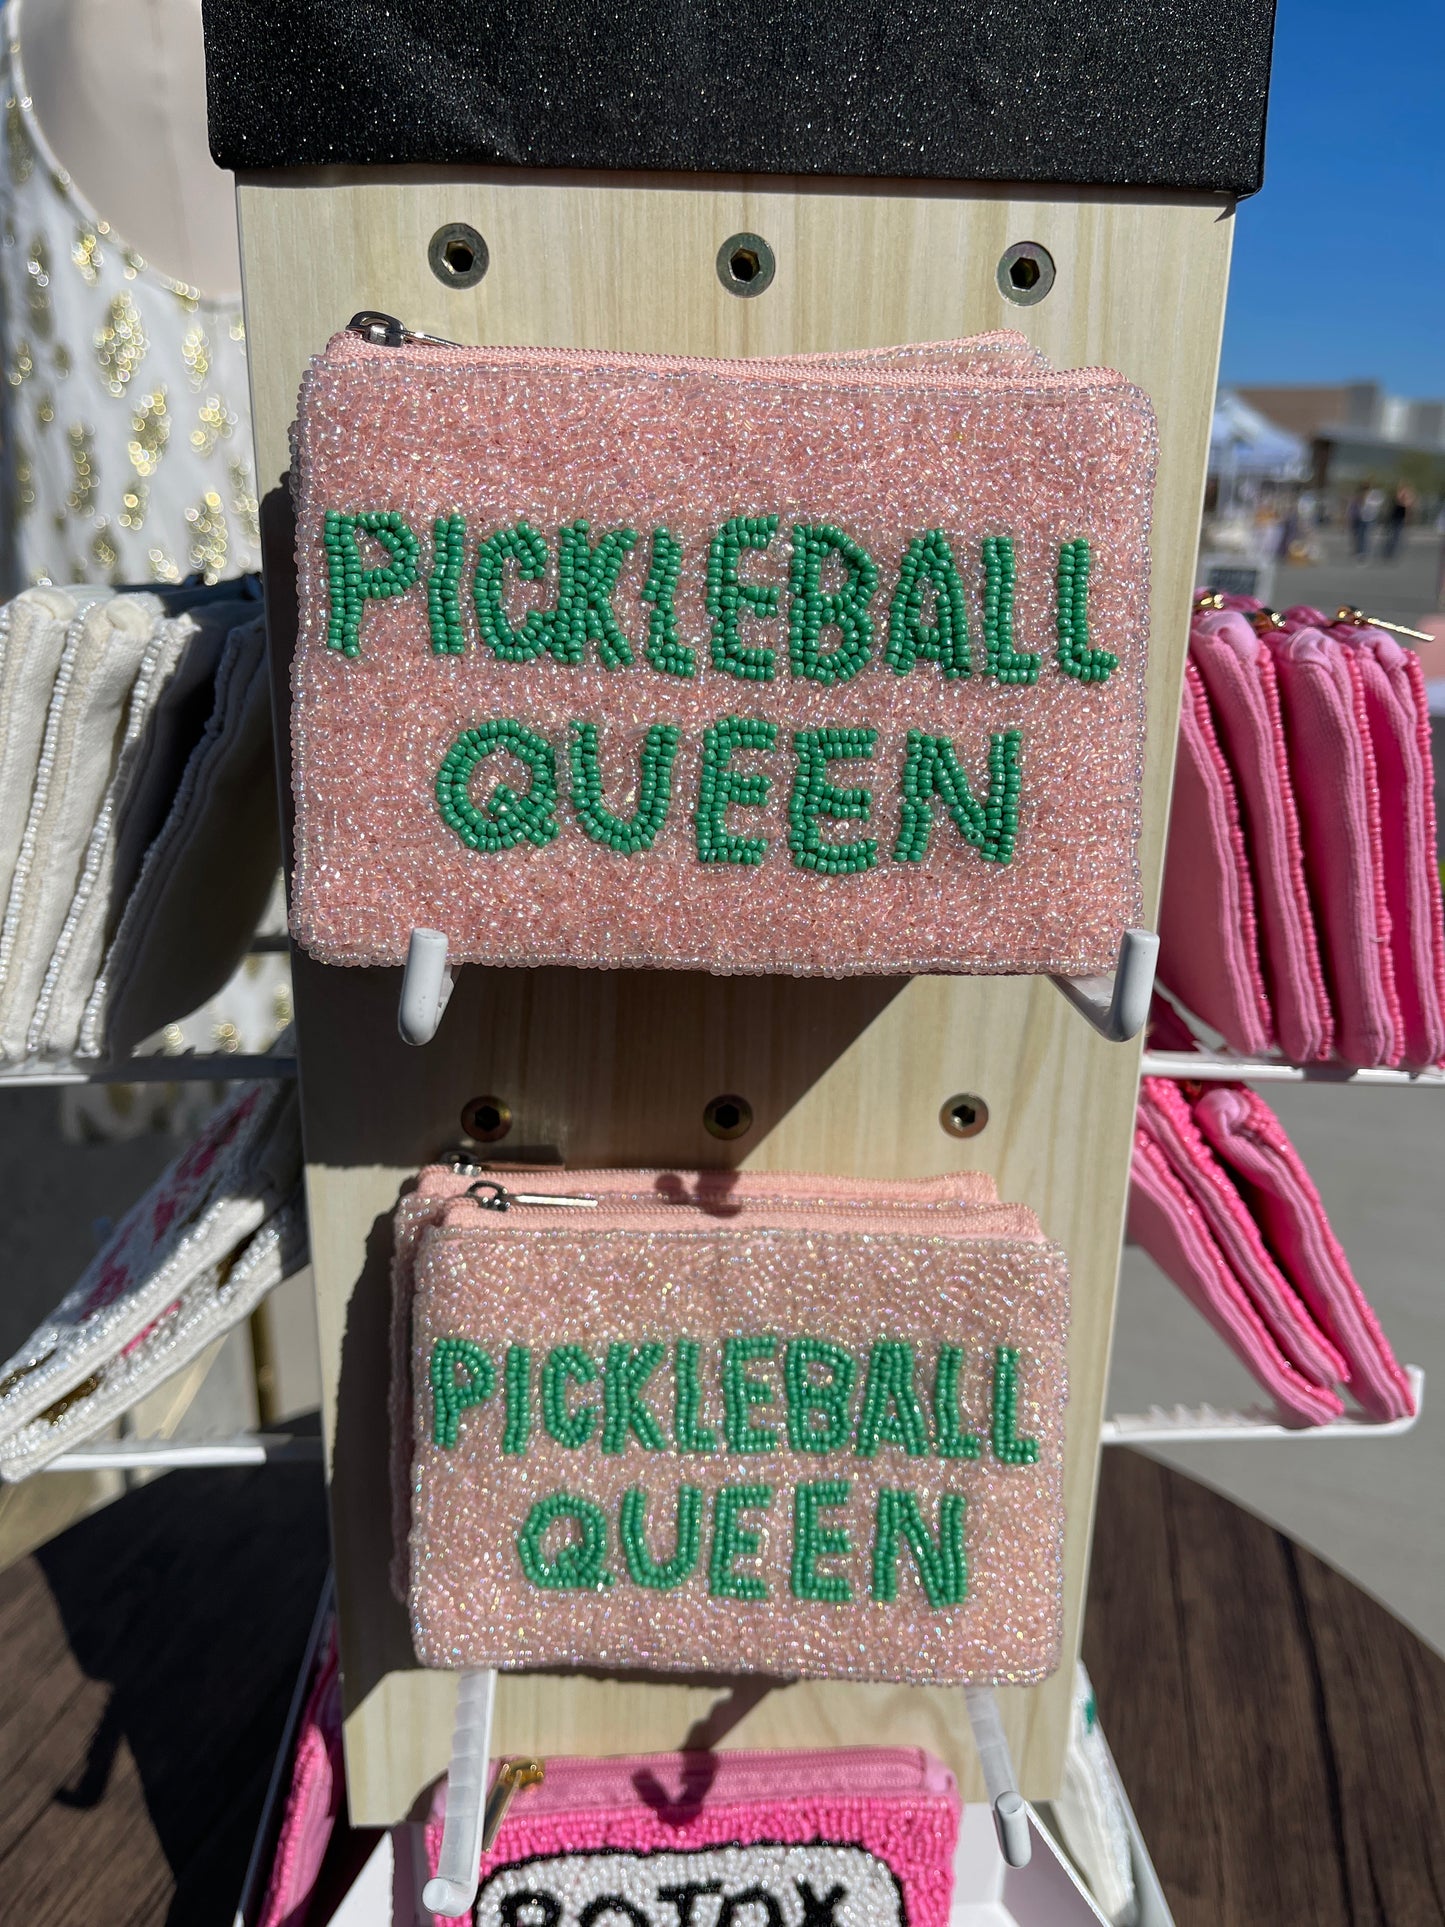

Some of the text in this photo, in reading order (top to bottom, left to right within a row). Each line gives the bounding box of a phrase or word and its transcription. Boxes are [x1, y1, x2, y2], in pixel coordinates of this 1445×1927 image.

[325, 513, 1118, 686] PICKLEBALL
[437, 717, 1021, 875] QUEEN
[432, 1338, 1038, 1464] PICKLEBALL
[520, 1484, 966, 1608] QUEEN
